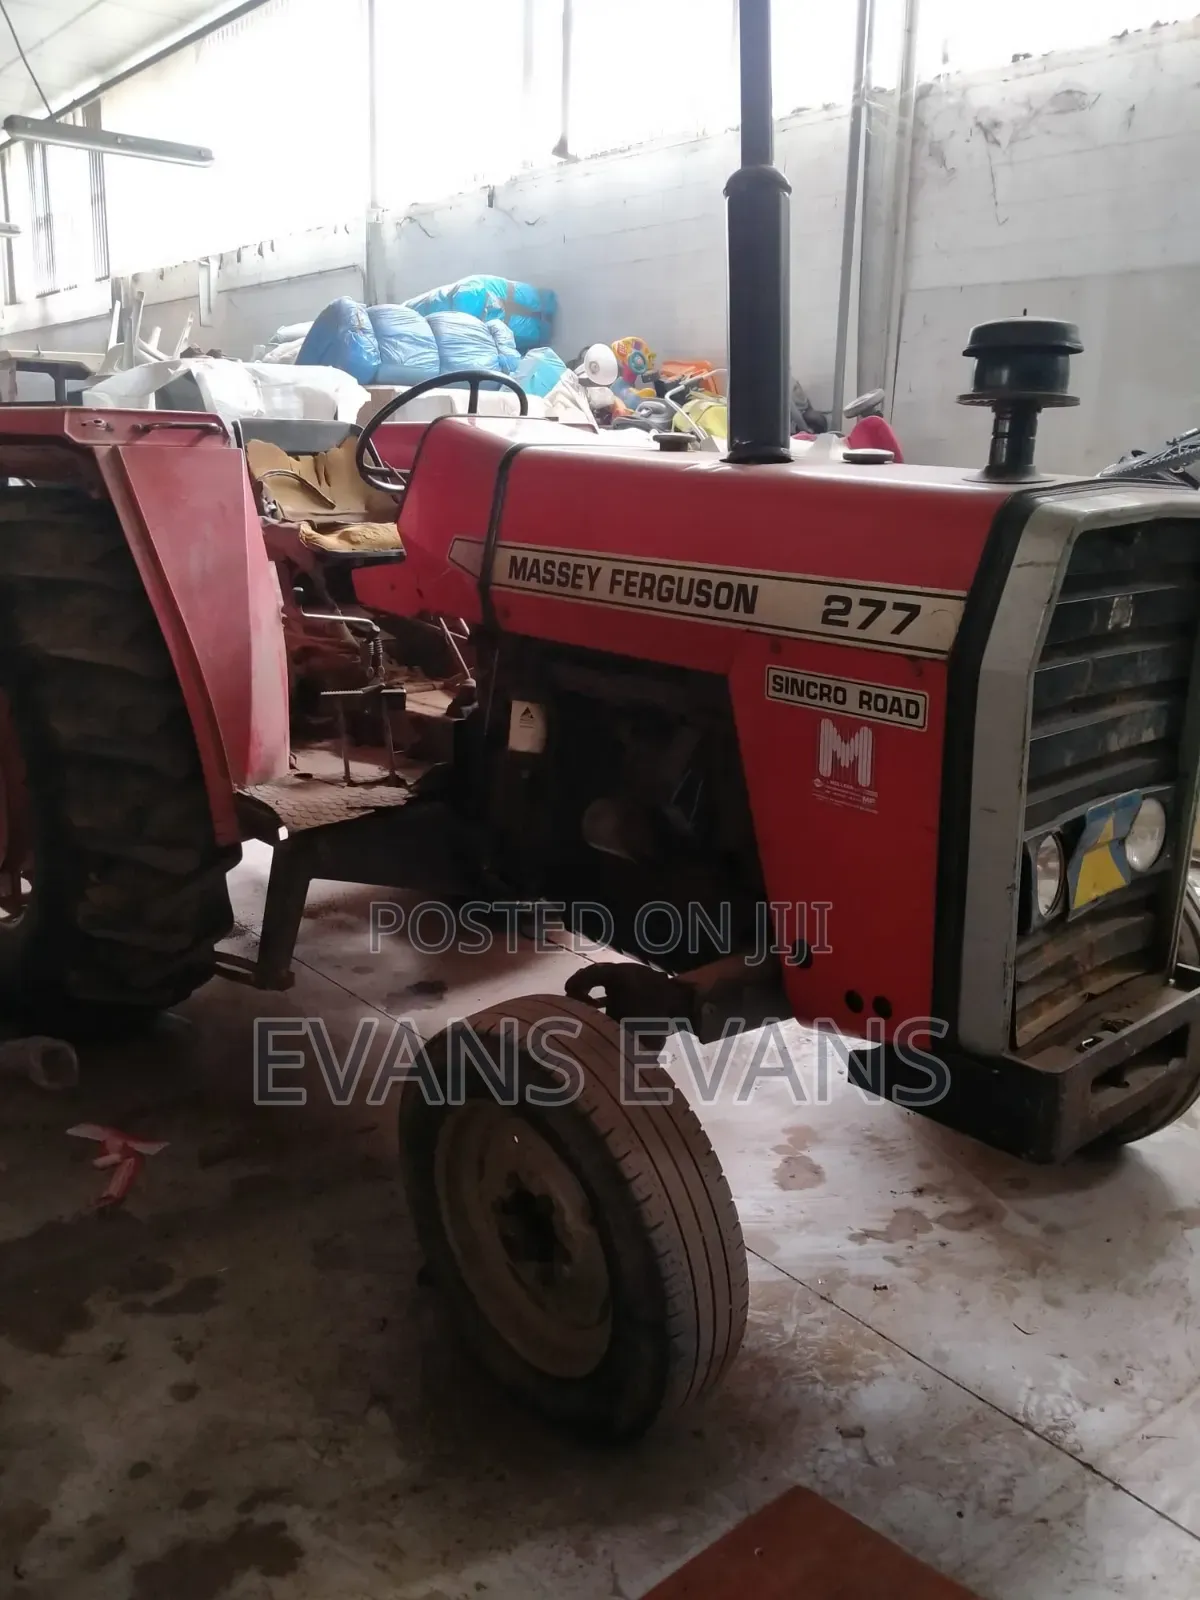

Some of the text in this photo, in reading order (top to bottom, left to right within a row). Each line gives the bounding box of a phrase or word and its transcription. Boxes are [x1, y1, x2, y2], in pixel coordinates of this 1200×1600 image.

[508, 555, 921, 635] MASSEY FERGUSON 277
[772, 674, 920, 720] SINCRO ROAD
